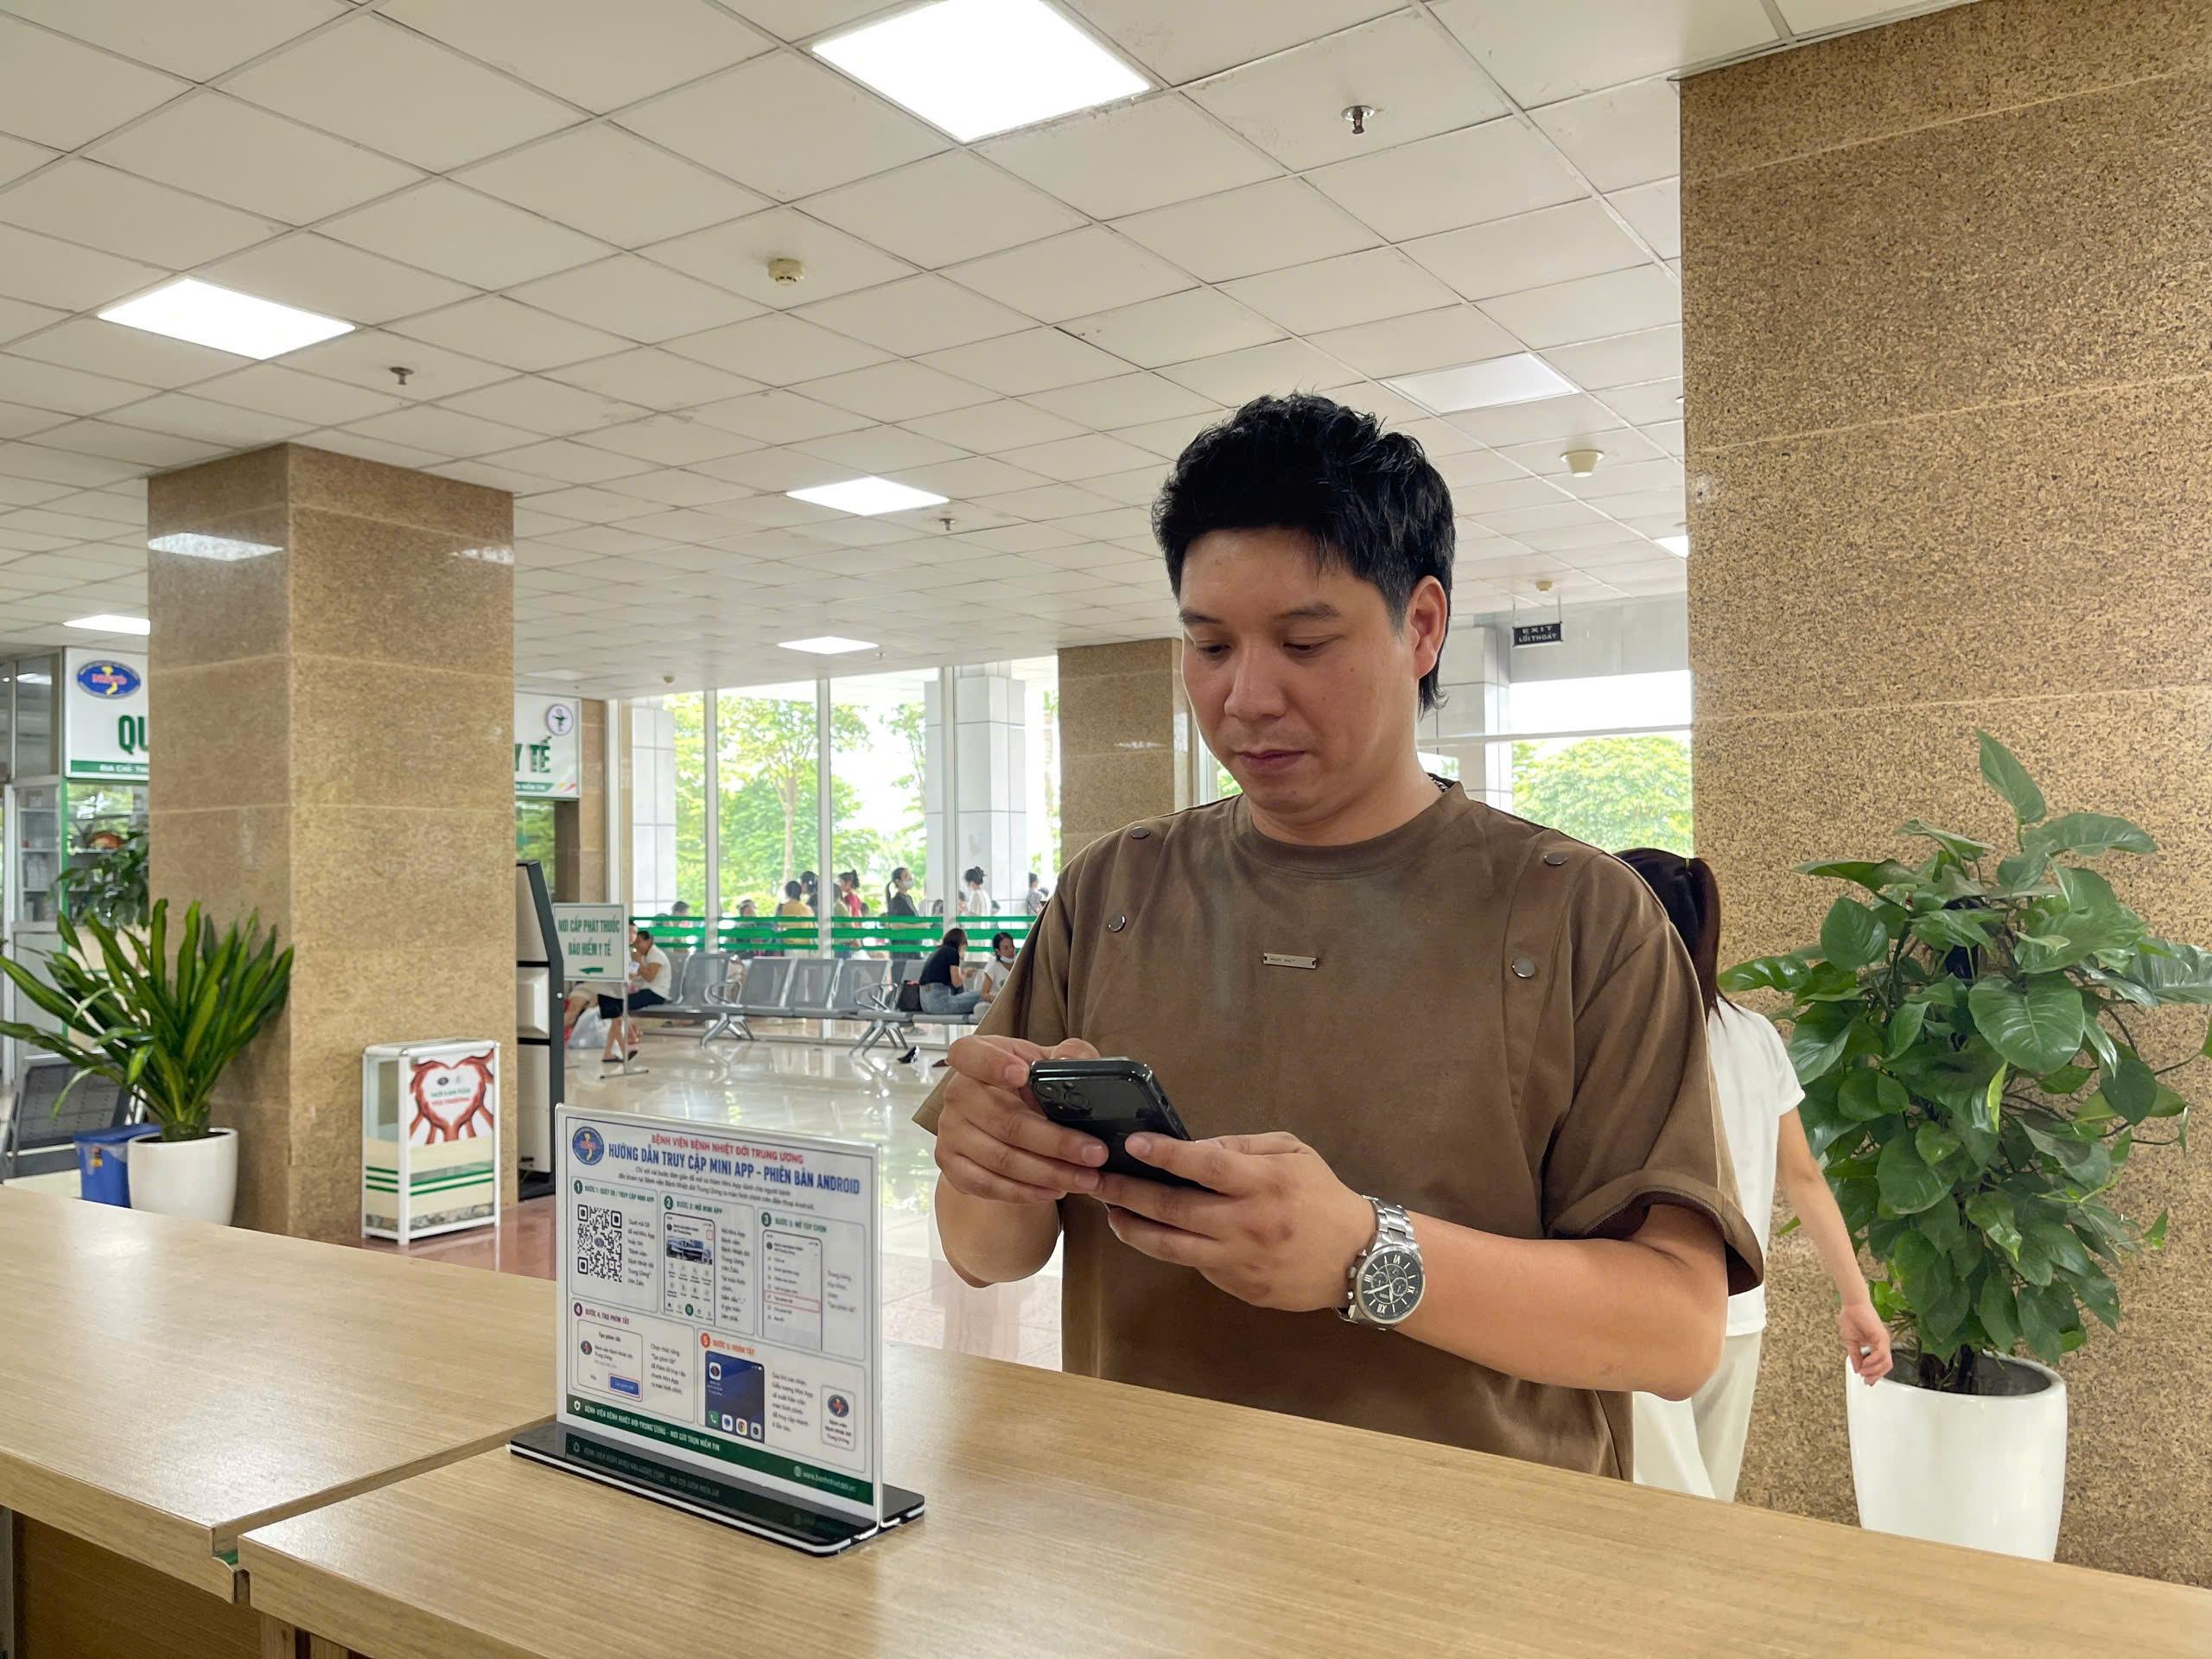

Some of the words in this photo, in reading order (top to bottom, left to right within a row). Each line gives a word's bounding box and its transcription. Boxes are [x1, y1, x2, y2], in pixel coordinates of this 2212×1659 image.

[1522, 626, 1553, 634] EXIT
[529, 735, 552, 773] TẾ
[583, 918, 600, 932] PHÁT
[568, 938, 580, 955] BẢO
[599, 943, 602, 956] Y
[652, 1133, 671, 1147] BỆNH
[671, 1135, 689, 1149] VIỆN
[690, 1138, 709, 1153] BỆNH
[713, 1141, 734, 1156] NHIỆT
[736, 1144, 749, 1157] ĐỚI
[752, 1148, 778, 1161] TRUNG
[780, 1151, 804, 1165] ƯƠNG
[609, 1141, 638, 1161] HƯỚNG
[641, 1143, 659, 1165] DẪN
[662, 1151, 685, 1168] TRUY
[688, 1152, 707, 1175] CẬP
[710, 1158, 732, 1175] MINI
[734, 1161, 754, 1179] APP
[764, 1162, 791, 1185] PHIÊN
[794, 1166, 814, 1188] BẢN
[817, 1173, 861, 1195] ANDROID
